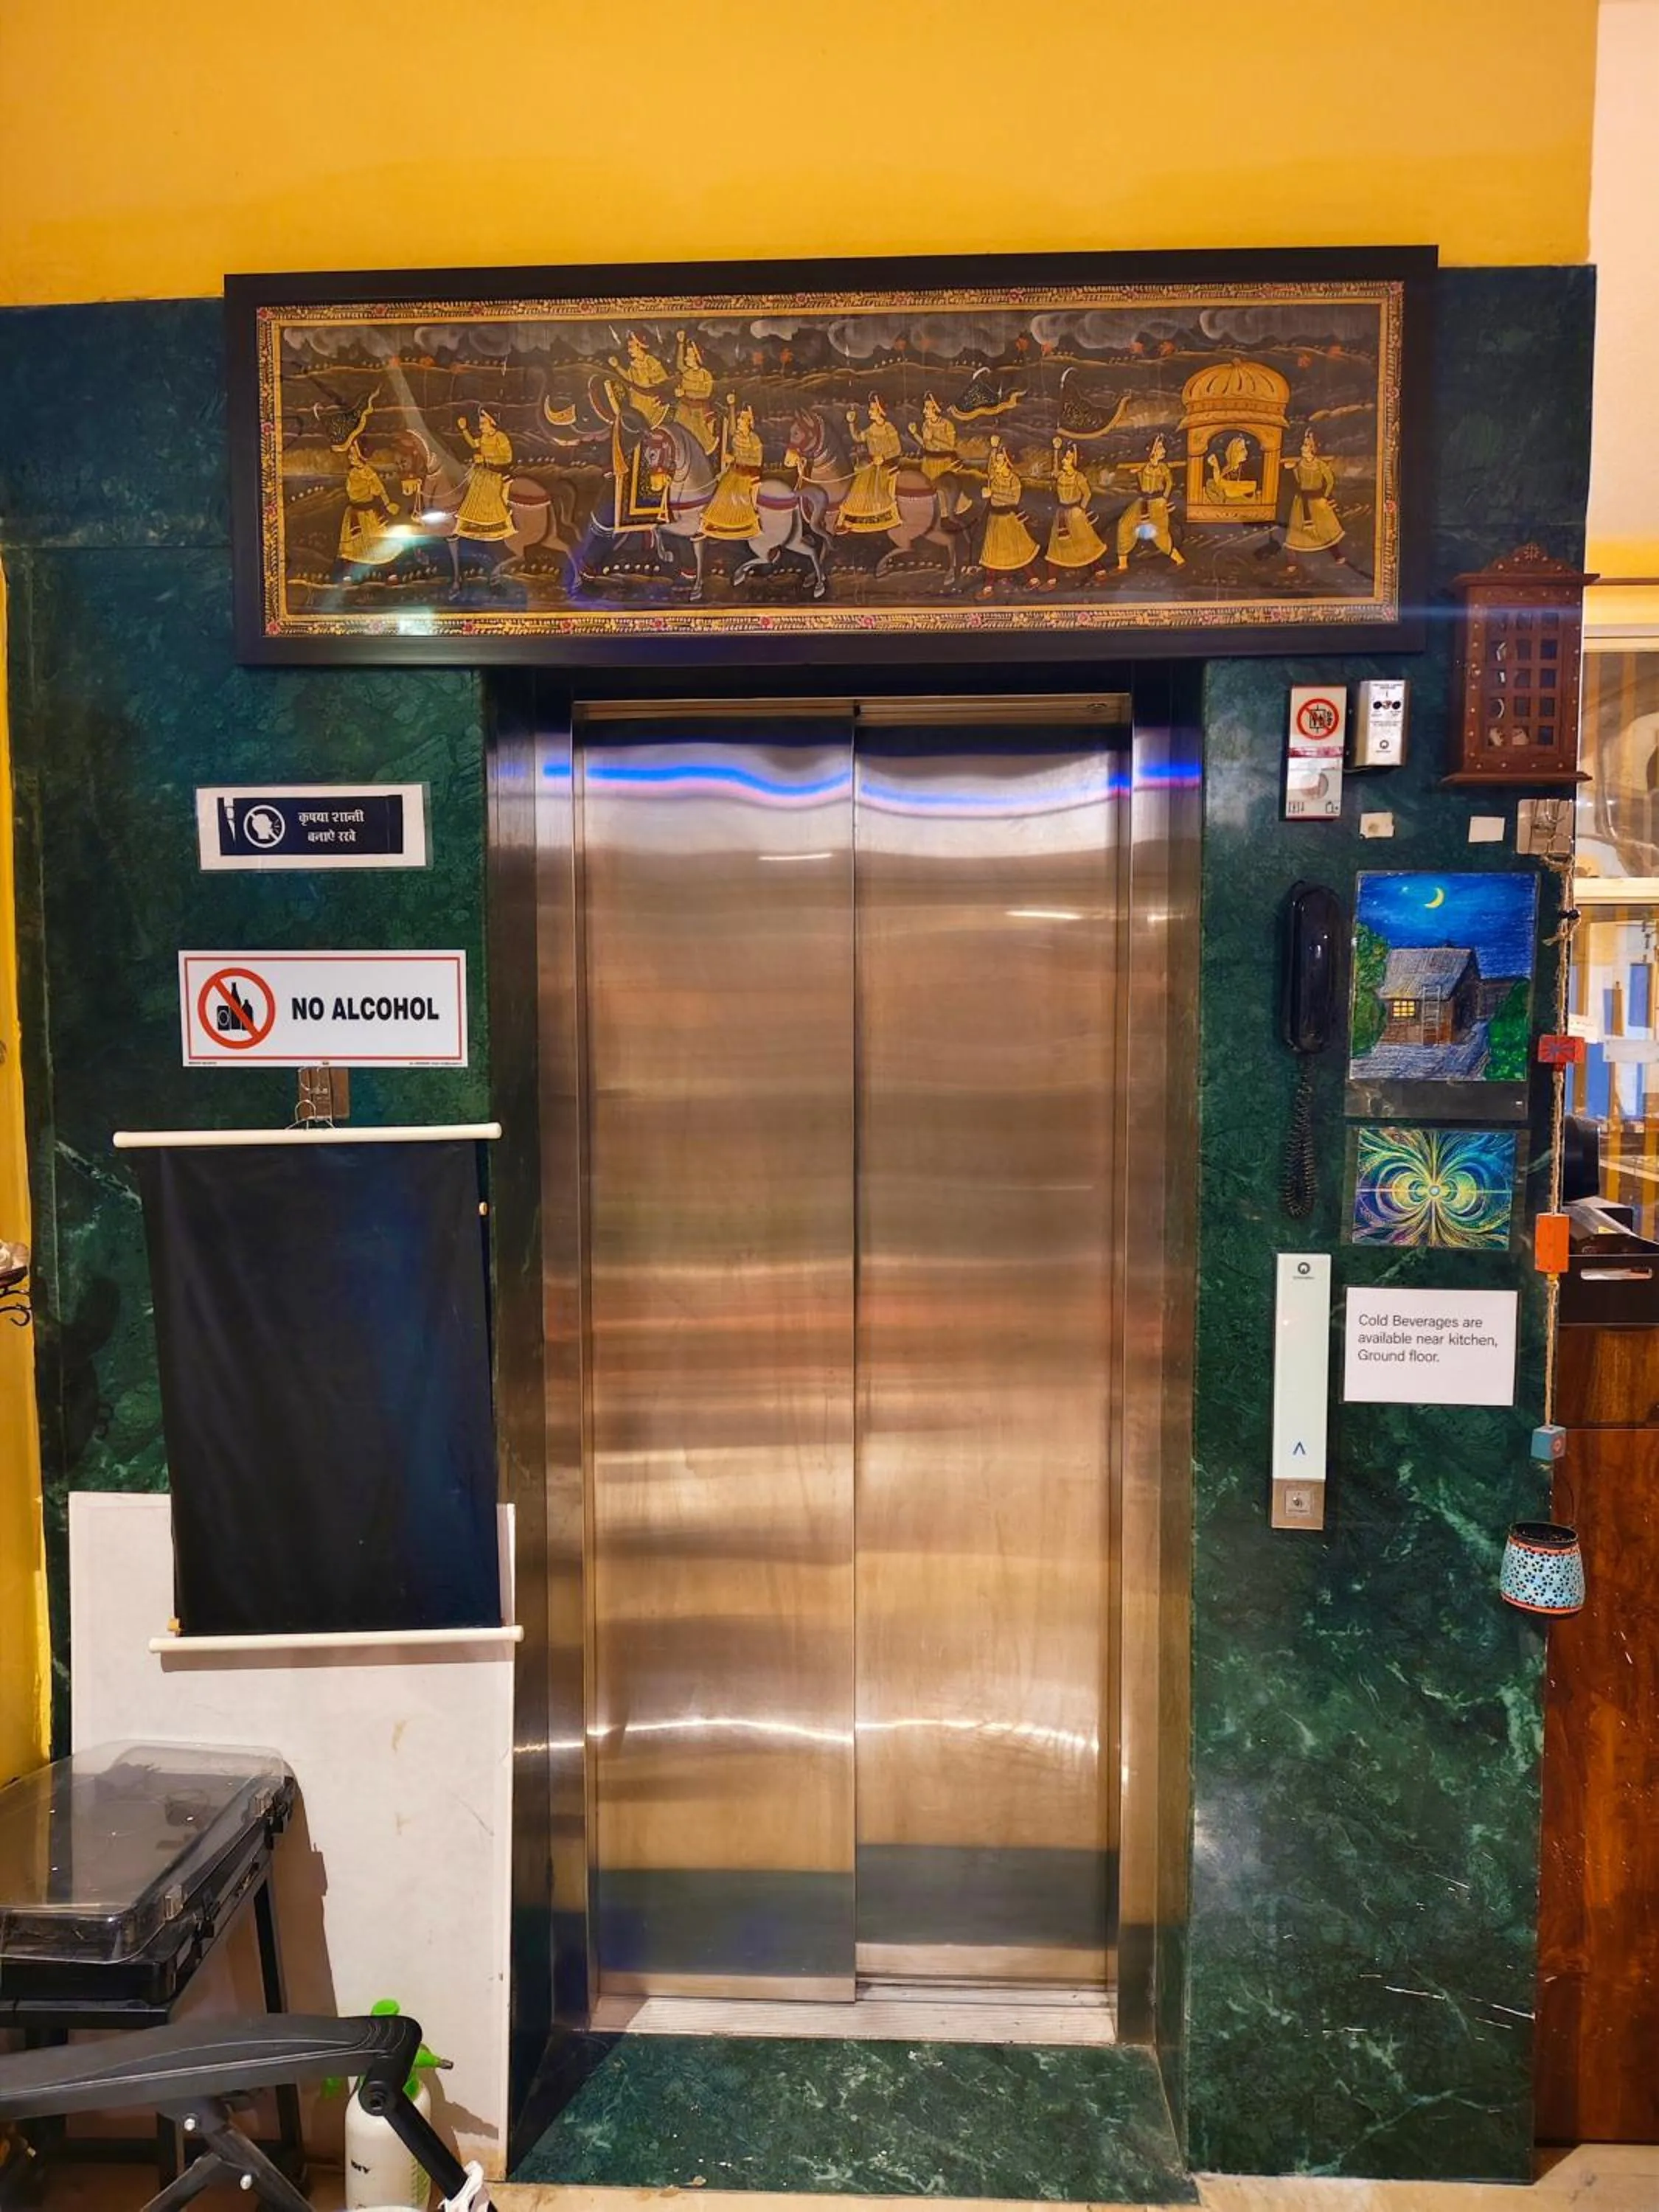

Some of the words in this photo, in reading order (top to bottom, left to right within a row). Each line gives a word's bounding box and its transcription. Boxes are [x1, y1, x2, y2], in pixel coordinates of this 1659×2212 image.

[297, 812, 330, 826] कृपया
[291, 997, 325, 1020] NO
[331, 997, 439, 1020] ALCOHOL
[1358, 1314, 1388, 1326] Cold
[1392, 1315, 1459, 1329] Beverages
[1462, 1318, 1483, 1328] are
[1357, 1332, 1412, 1344] available
[1416, 1335, 1444, 1345] near
[1448, 1333, 1498, 1348] kitchen,
[1357, 1349, 1405, 1362] Ground
[1409, 1350, 1440, 1363] floor.
